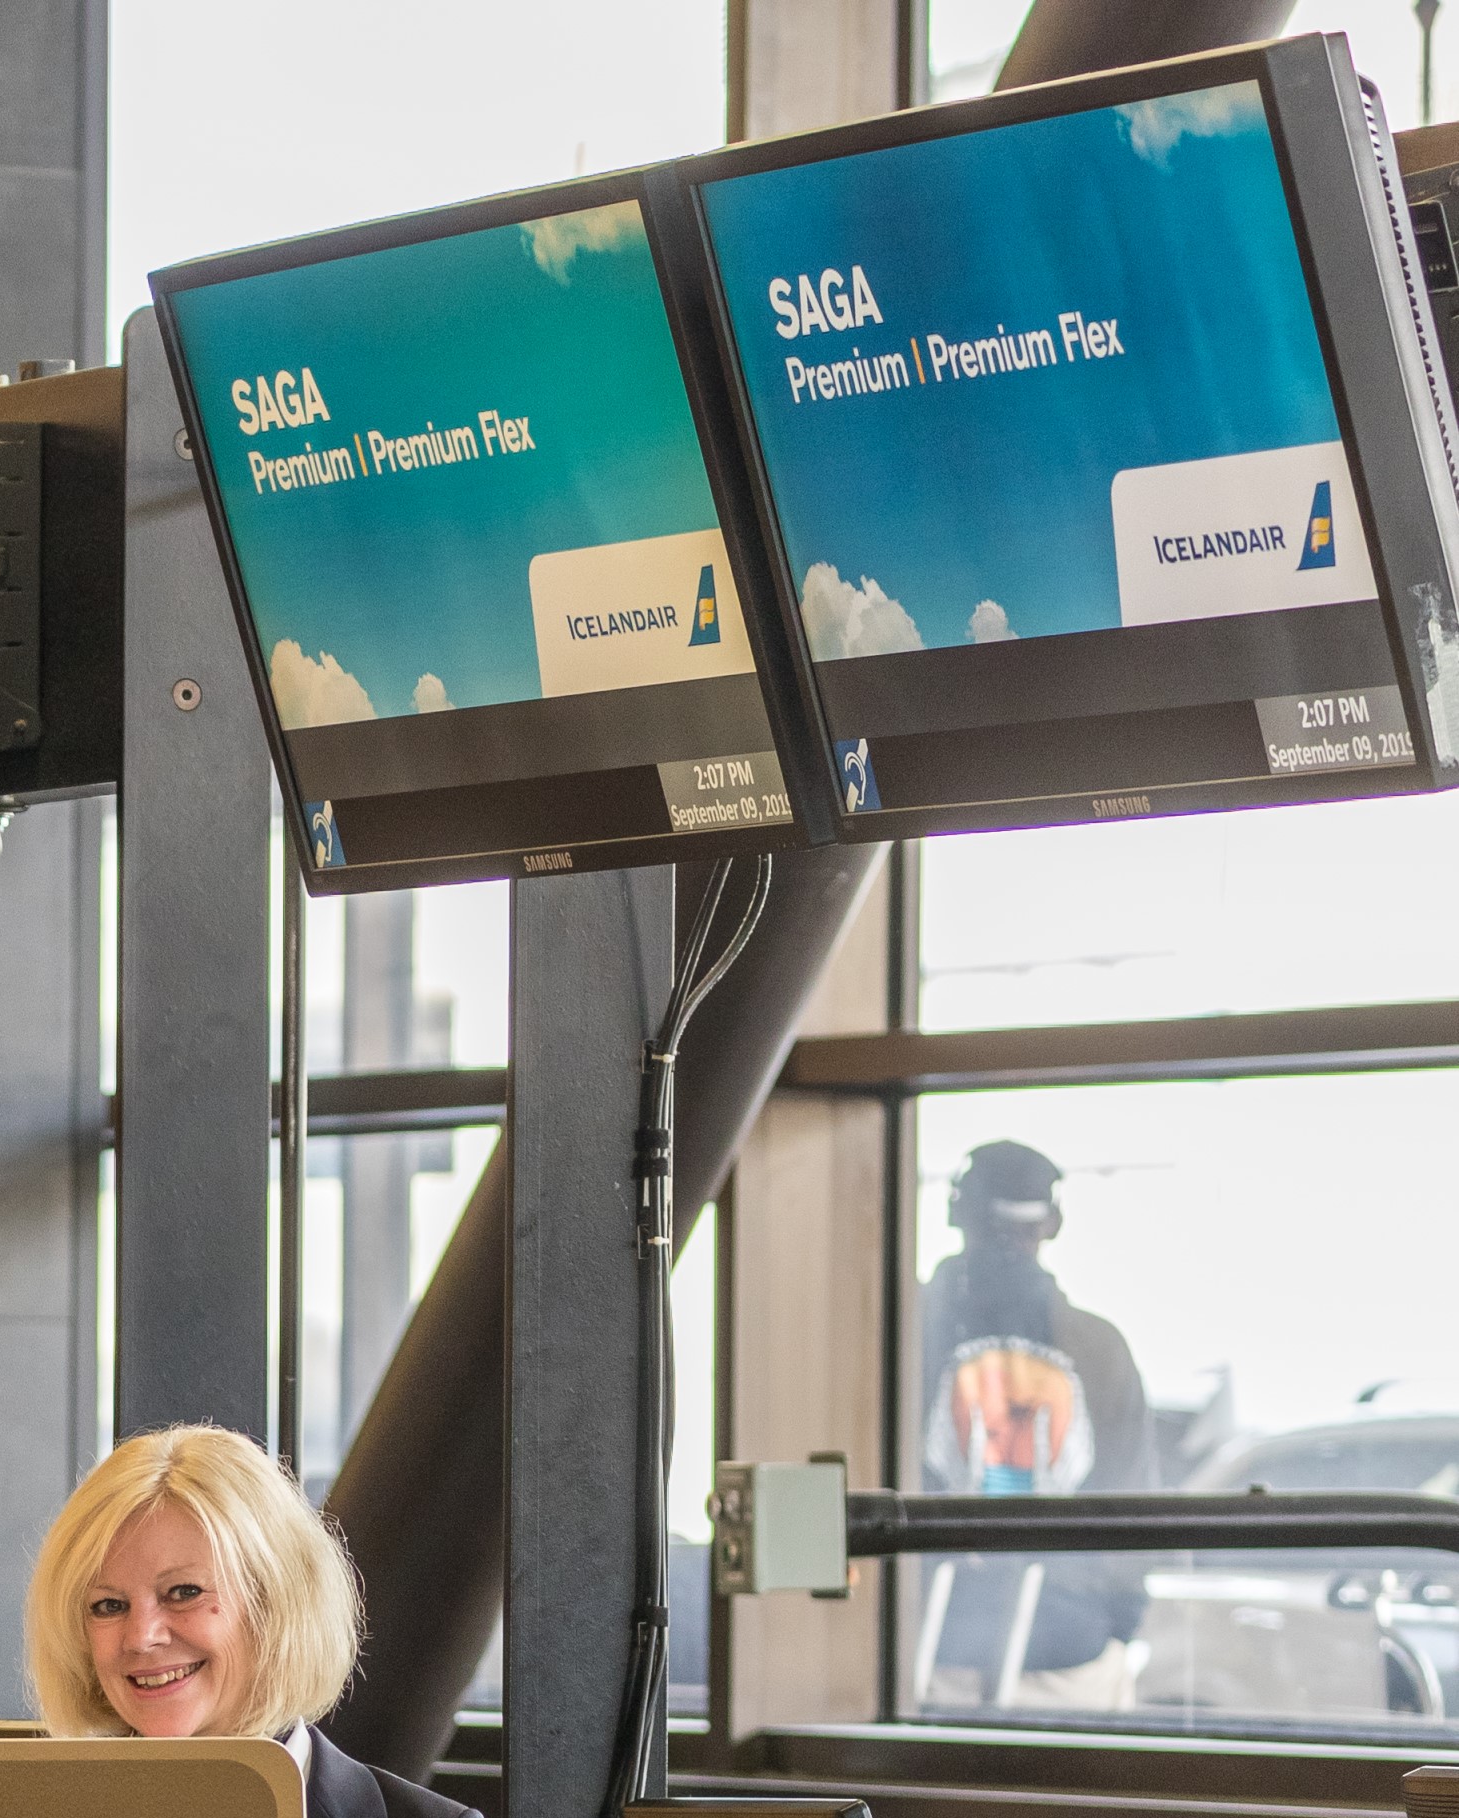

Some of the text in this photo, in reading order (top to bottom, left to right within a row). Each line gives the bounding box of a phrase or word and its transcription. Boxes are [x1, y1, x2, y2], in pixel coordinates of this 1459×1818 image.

[769, 264, 883, 340] SAGA
[785, 347, 910, 403] Premium
[927, 324, 1057, 382] Premium
[1058, 311, 1125, 362] Flex
[231, 367, 331, 436] SAGA
[247, 442, 355, 495] Premium
[367, 421, 479, 475] Premium
[478, 409, 536, 456] Flex
[1154, 525, 1286, 564] ICELANDAIR
[566, 605, 678, 641] ICELANDAIR
[1298, 695, 1370, 728] 2:07 PM
[1269, 737, 1350, 772] September
[1352, 734, 1378, 764] 09,
[693, 760, 755, 791] 2:07 PM
[670, 799, 739, 830] September
[740, 797, 763, 821] 09,
[1092, 796, 1151, 817] SAMSUNG
[523, 852, 573, 872] SAMSUNG
